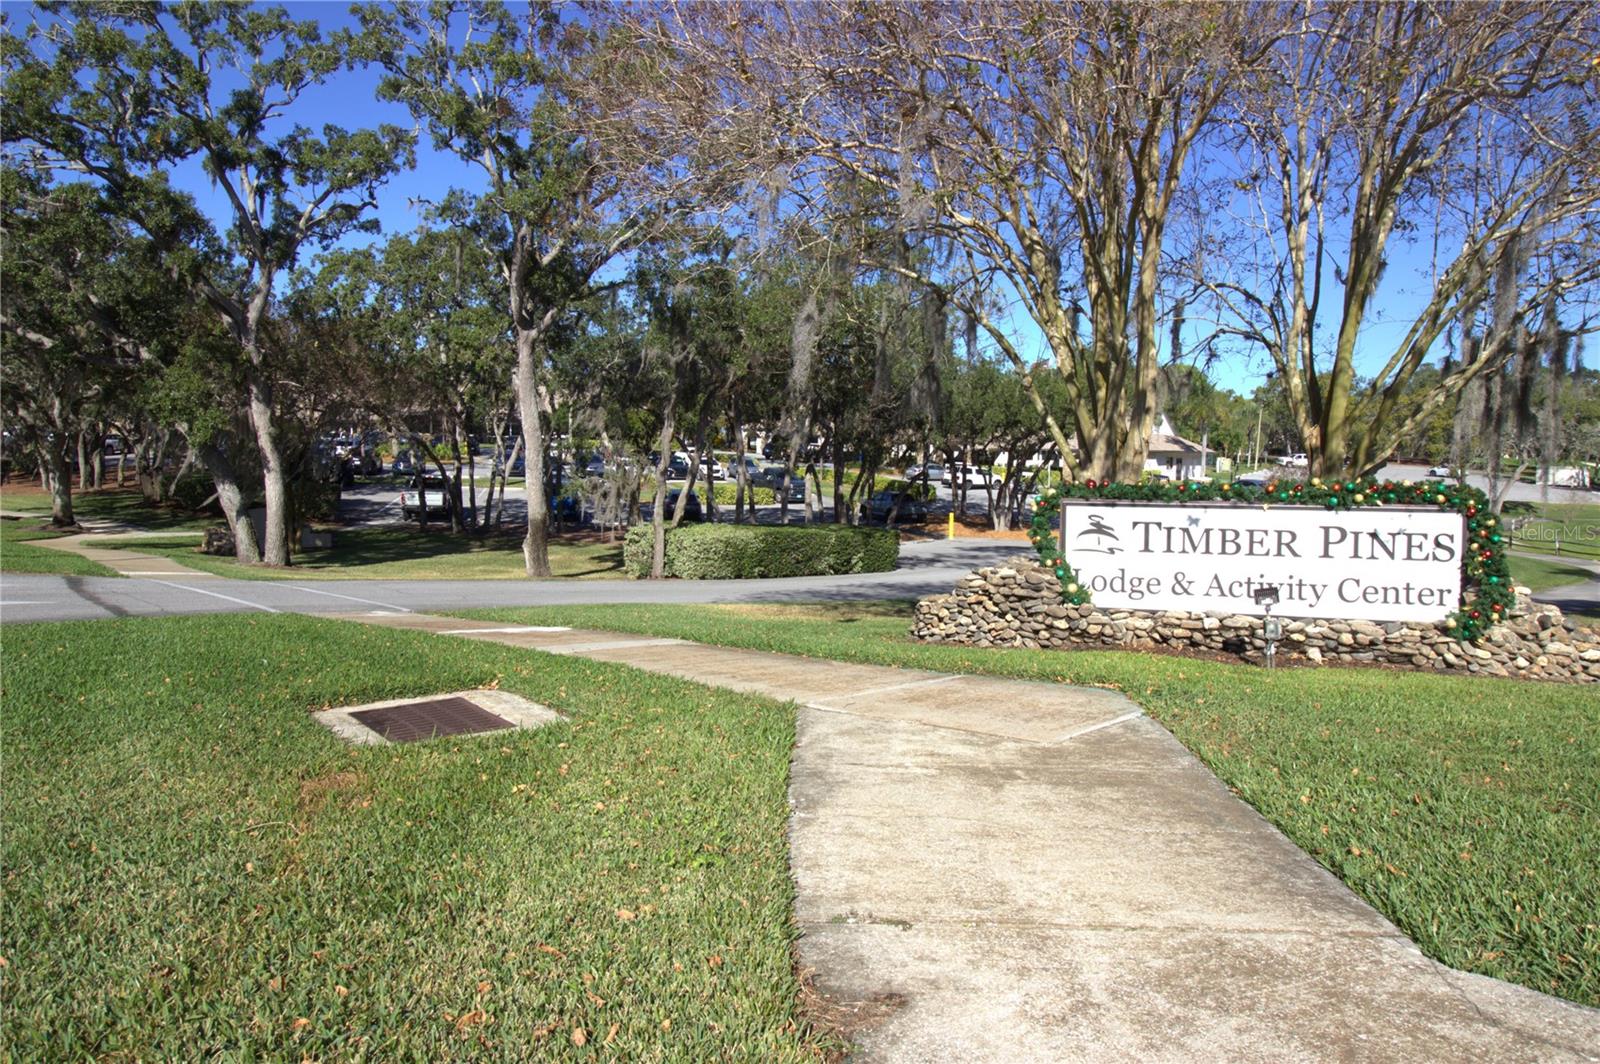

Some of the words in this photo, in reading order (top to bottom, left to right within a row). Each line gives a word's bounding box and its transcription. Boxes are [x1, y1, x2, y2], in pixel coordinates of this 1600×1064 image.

[1132, 521, 1301, 558] TIMBER
[1319, 525, 1456, 562] PINES
[1073, 568, 1161, 600] Lodge
[1171, 571, 1195, 596] &
[1338, 577, 1452, 607] Center
